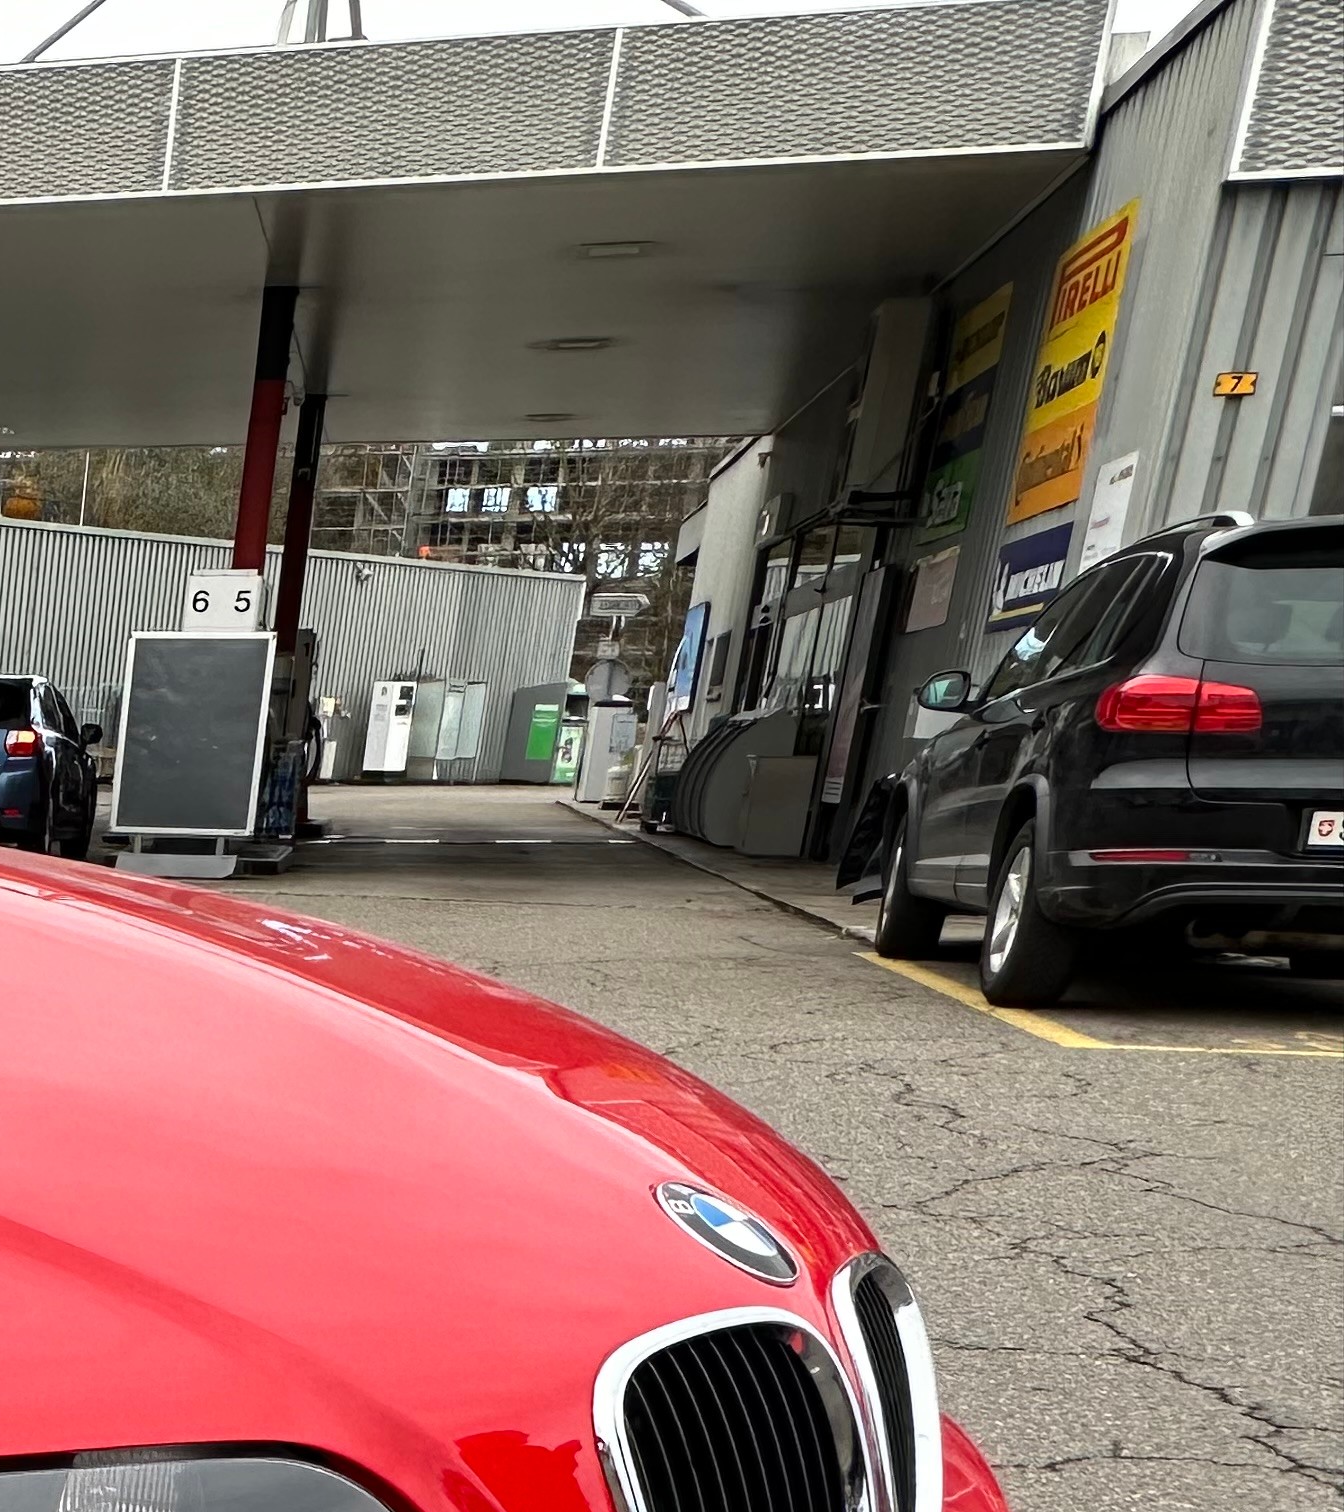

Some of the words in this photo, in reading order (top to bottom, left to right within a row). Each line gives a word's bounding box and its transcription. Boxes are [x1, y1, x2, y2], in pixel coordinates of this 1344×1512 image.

[1050, 215, 1129, 332] PIRELLI
[1230, 375, 1243, 392] 7
[192, 590, 210, 613] 6
[234, 590, 251, 613] 5
